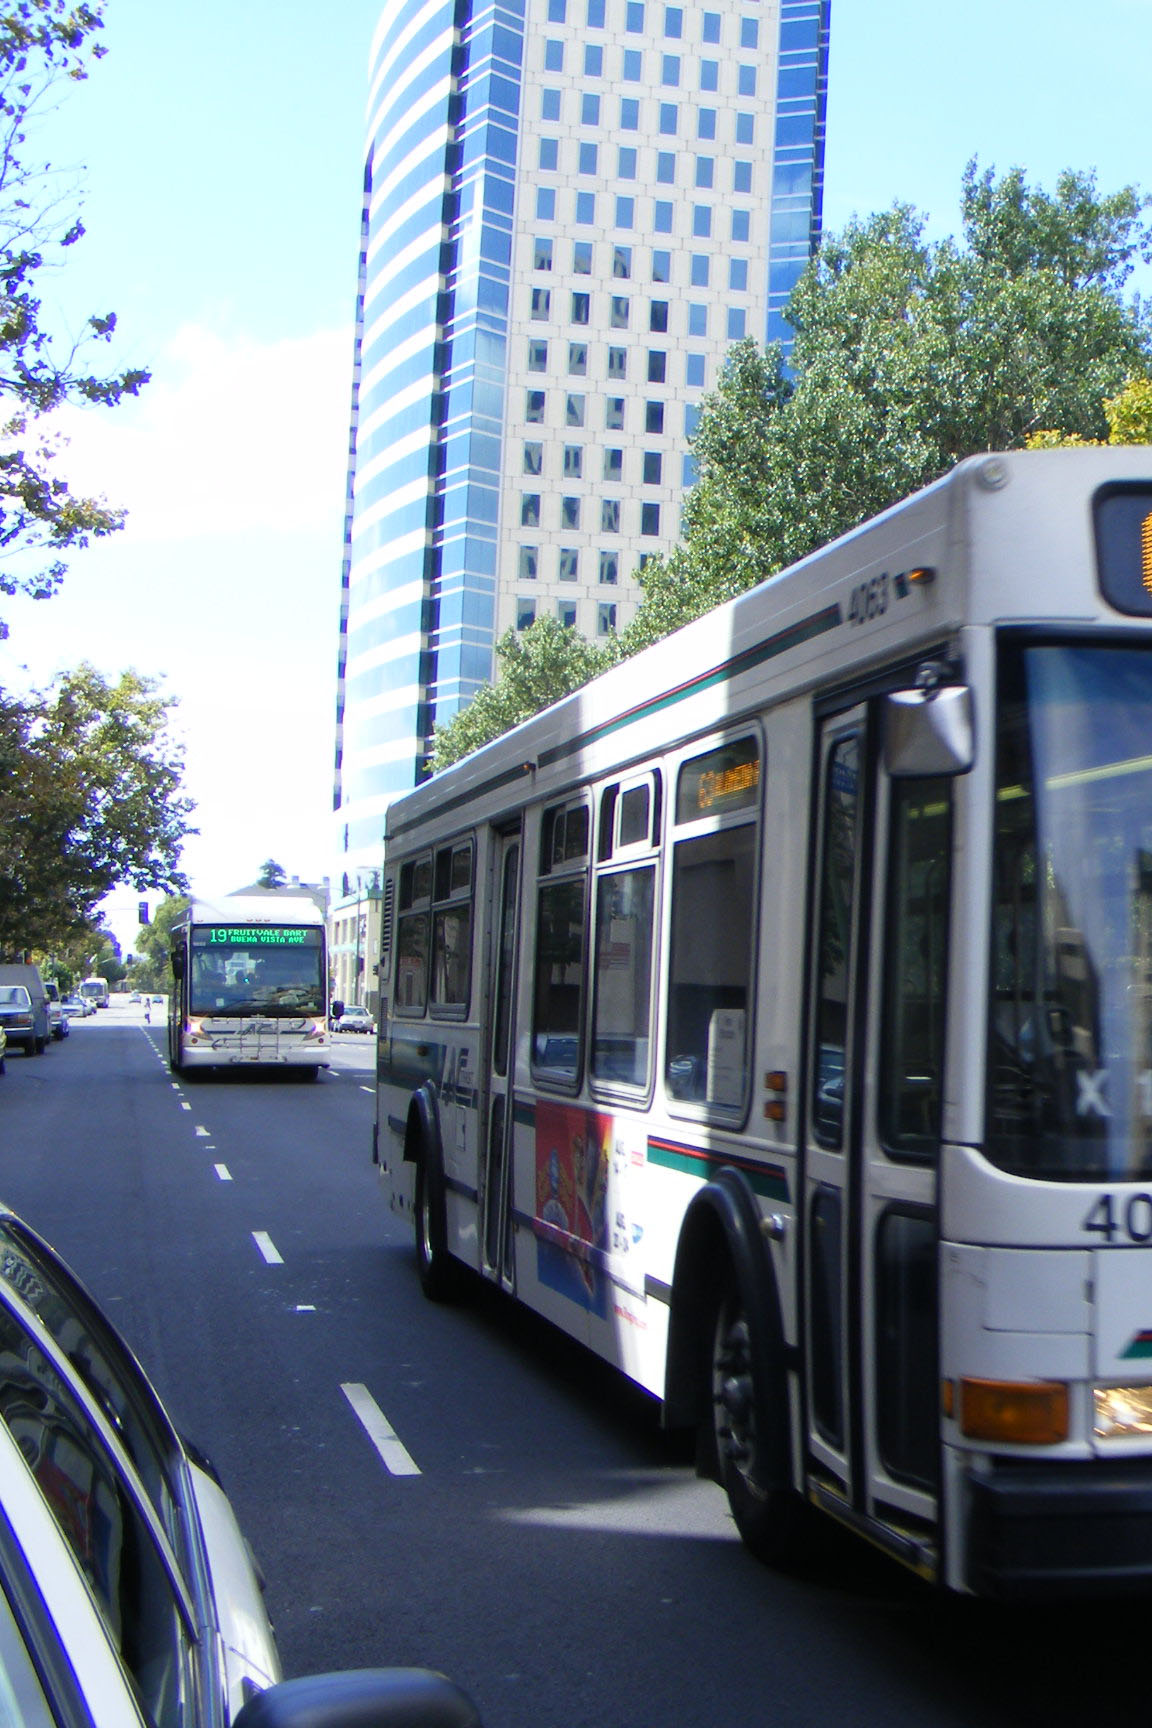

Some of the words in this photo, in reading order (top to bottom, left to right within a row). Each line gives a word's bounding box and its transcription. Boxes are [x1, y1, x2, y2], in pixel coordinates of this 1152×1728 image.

[210, 928, 227, 943] 19
[228, 929, 281, 937] FRUITVALE
[283, 929, 308, 937] BART
